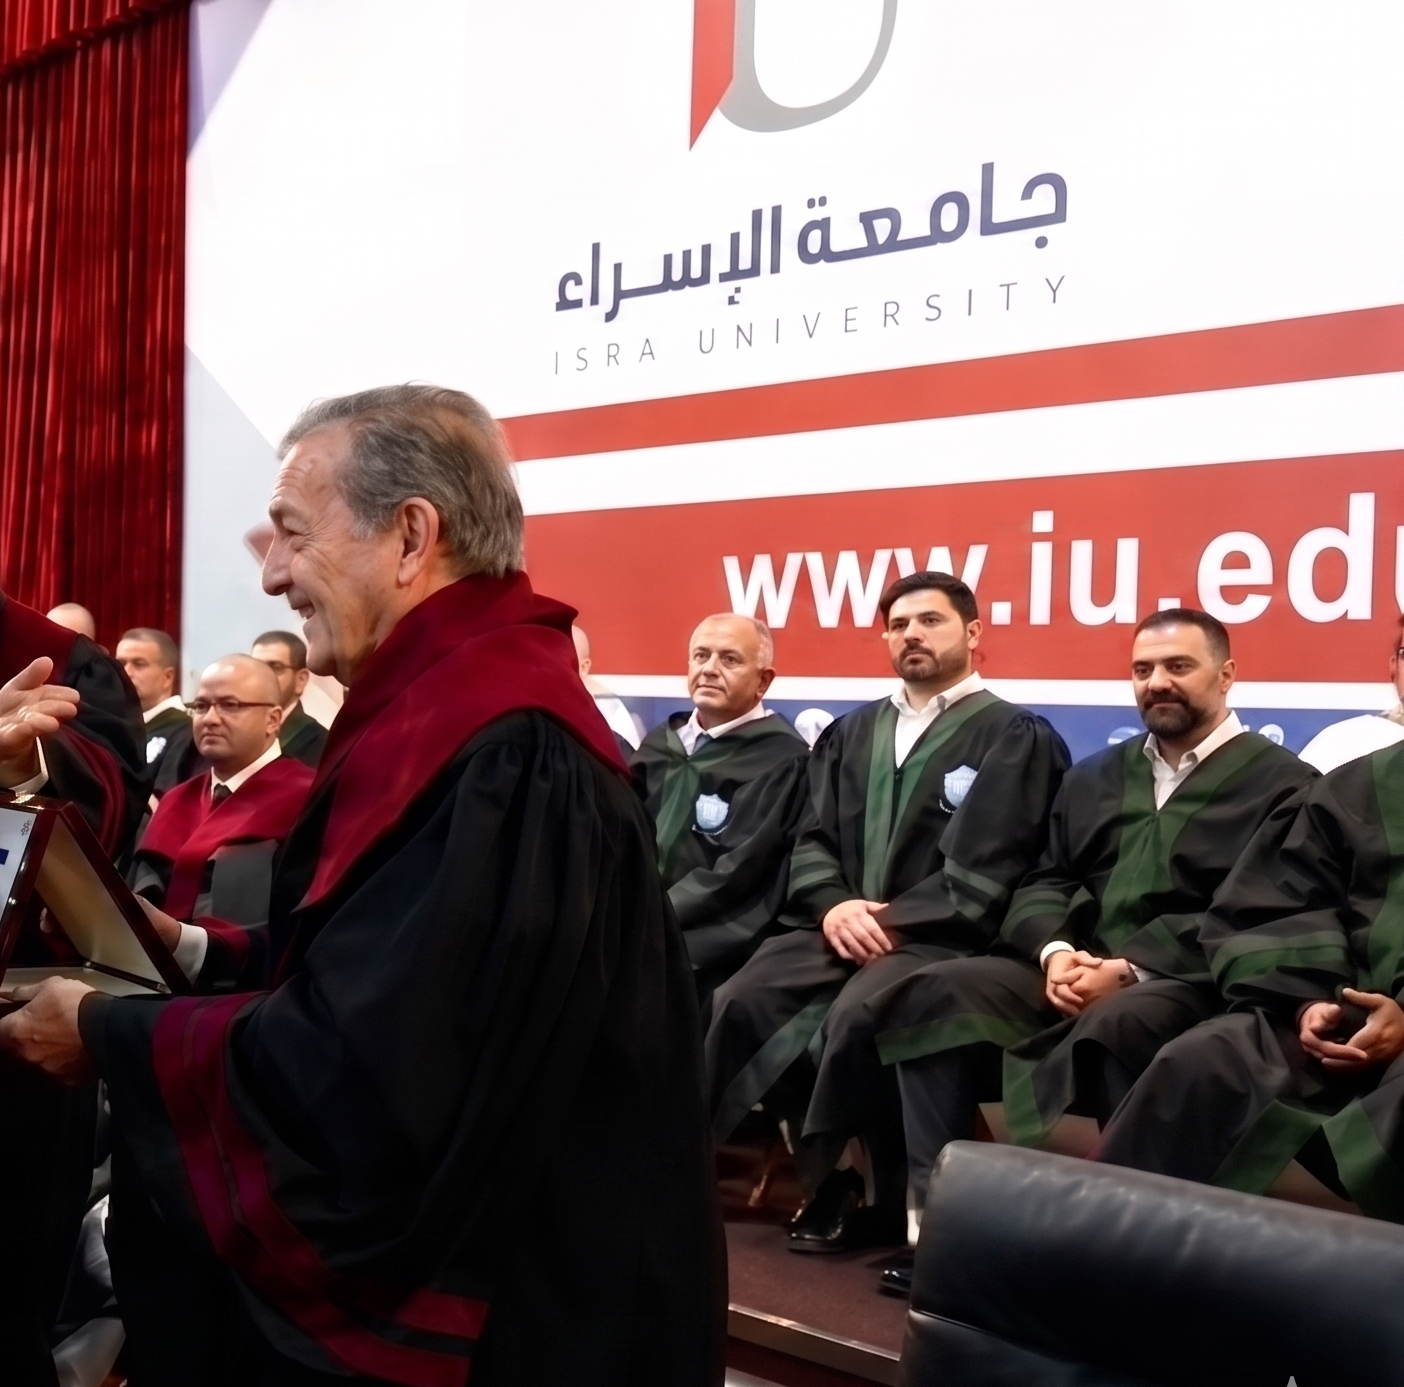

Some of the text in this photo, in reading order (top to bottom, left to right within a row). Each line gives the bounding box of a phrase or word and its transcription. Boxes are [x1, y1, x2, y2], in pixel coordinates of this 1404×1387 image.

[554, 161, 1068, 323] جامعة الإسراء
[553, 275, 1067, 375] ISRA UNIVERSITY
